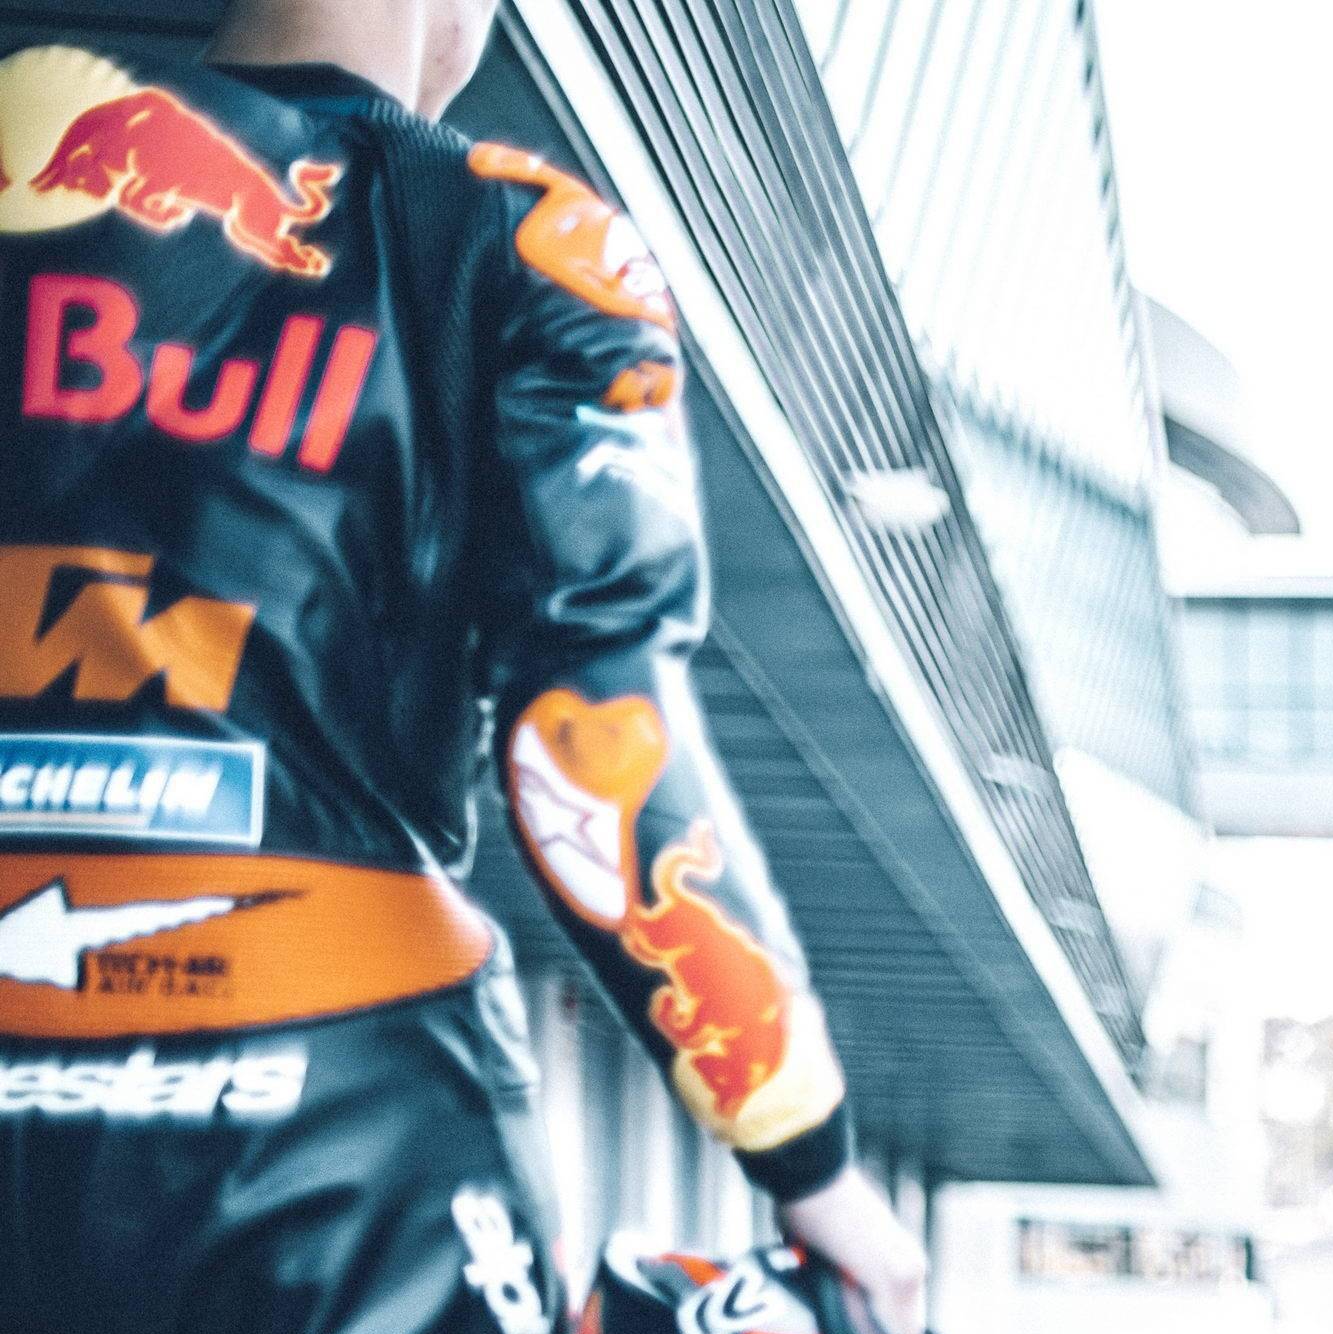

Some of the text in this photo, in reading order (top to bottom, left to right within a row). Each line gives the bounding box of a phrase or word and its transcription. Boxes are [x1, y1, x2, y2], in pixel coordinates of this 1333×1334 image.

[22, 272, 379, 474] Bull
[0, 545, 257, 714] TM
[0, 760, 223, 812] CHELIN
